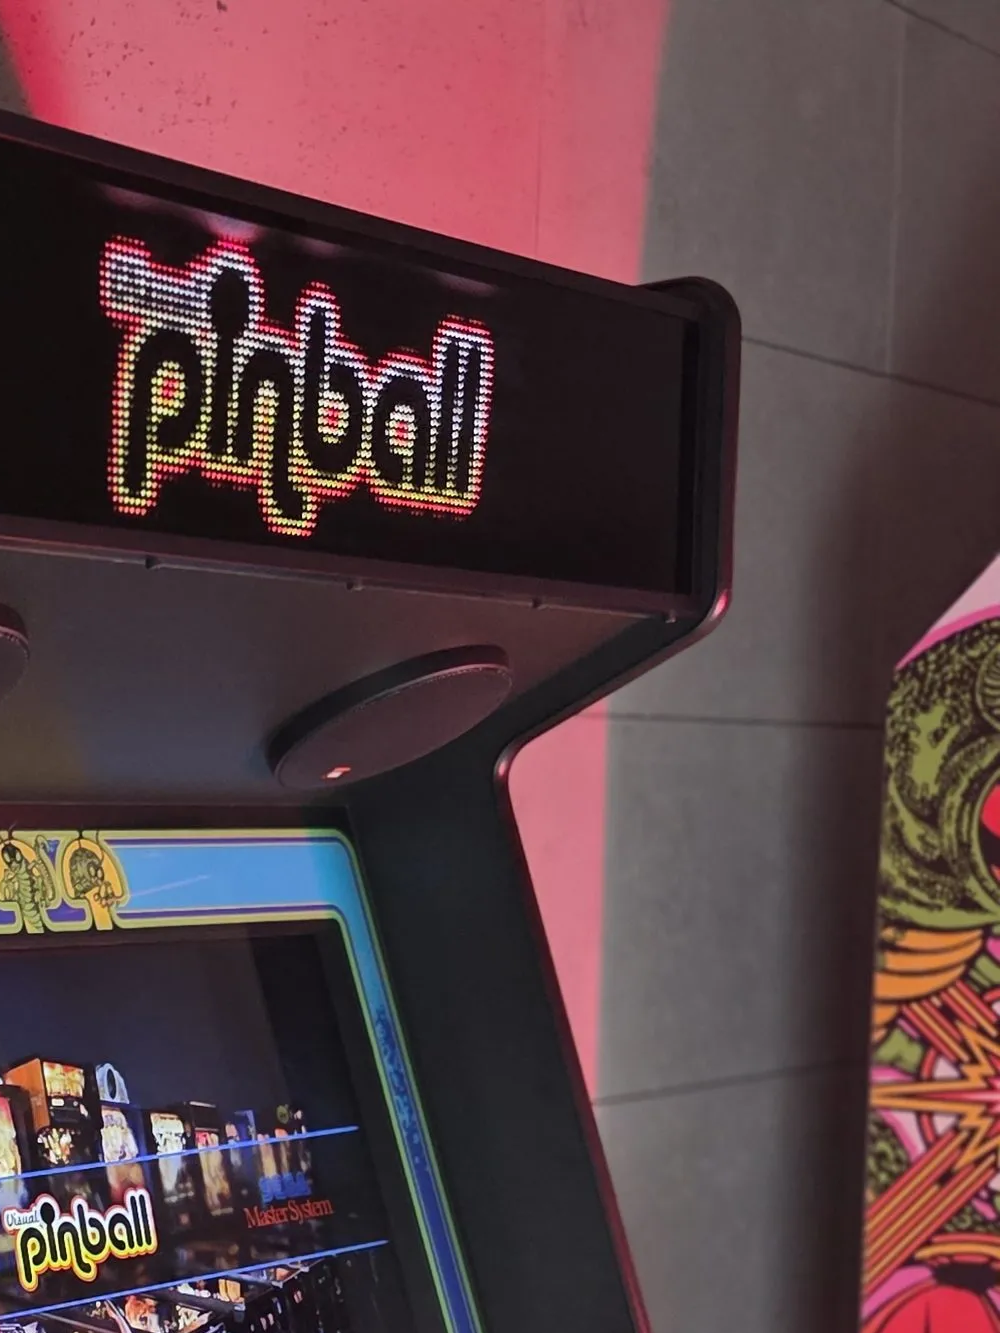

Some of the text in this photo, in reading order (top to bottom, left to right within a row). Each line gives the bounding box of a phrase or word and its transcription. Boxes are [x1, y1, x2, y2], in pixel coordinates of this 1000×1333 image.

[108, 238, 494, 536] pinball
[6, 1190, 156, 1287] Visual pinball
[243, 1199, 334, 1228] Master System
